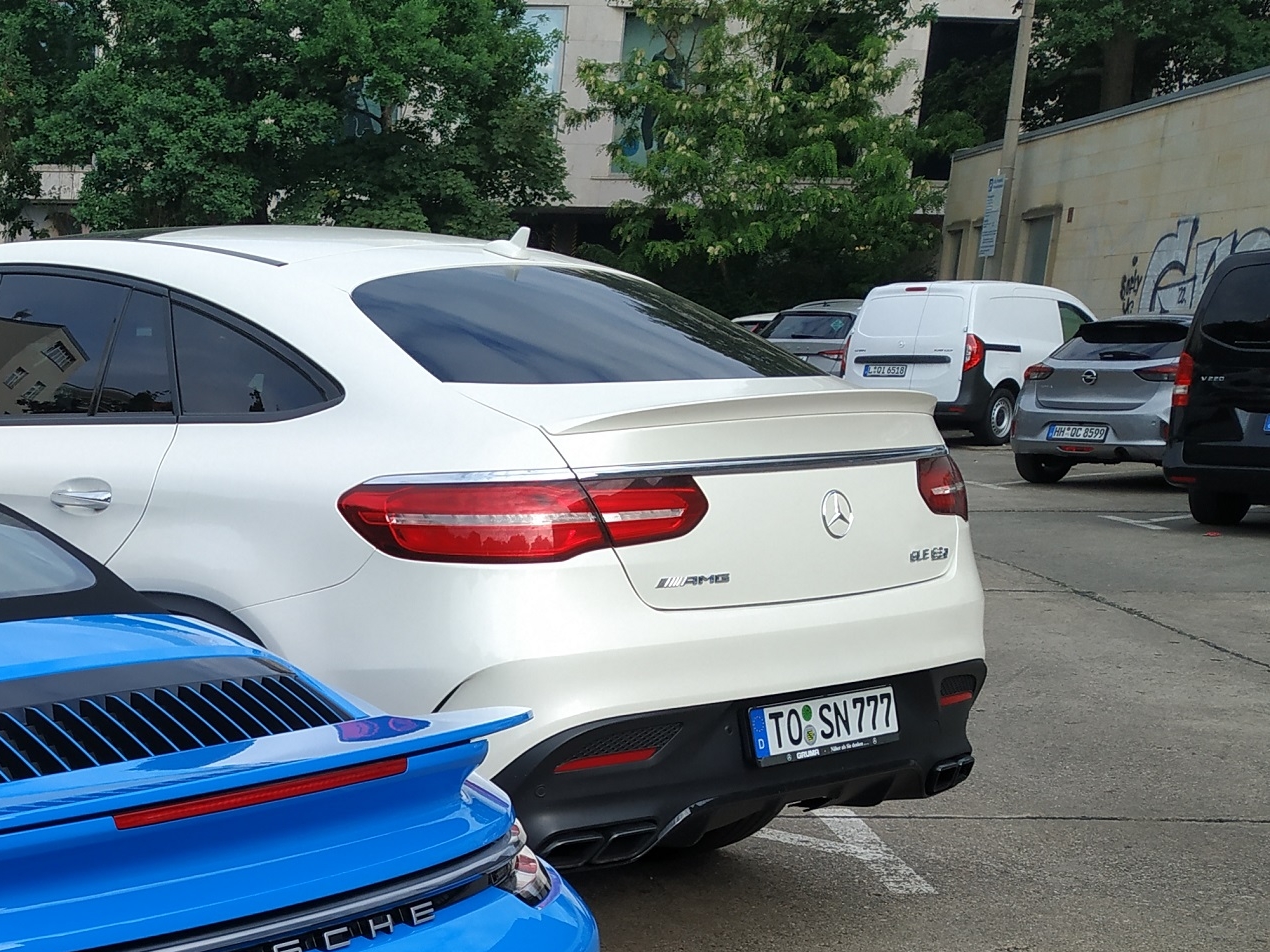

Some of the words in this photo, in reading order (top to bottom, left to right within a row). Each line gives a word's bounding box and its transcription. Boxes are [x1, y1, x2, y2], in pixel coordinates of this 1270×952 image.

[887, 366, 905, 374] 6518
[1053, 426, 1066, 437] HH
[1083, 428, 1105, 438] 8599
[758, 739, 765, 750] D
[768, 708, 803, 749] TO
[819, 700, 851, 740] SN
[852, 692, 892, 733] 777
[796, 748, 820, 760] GRUMA
